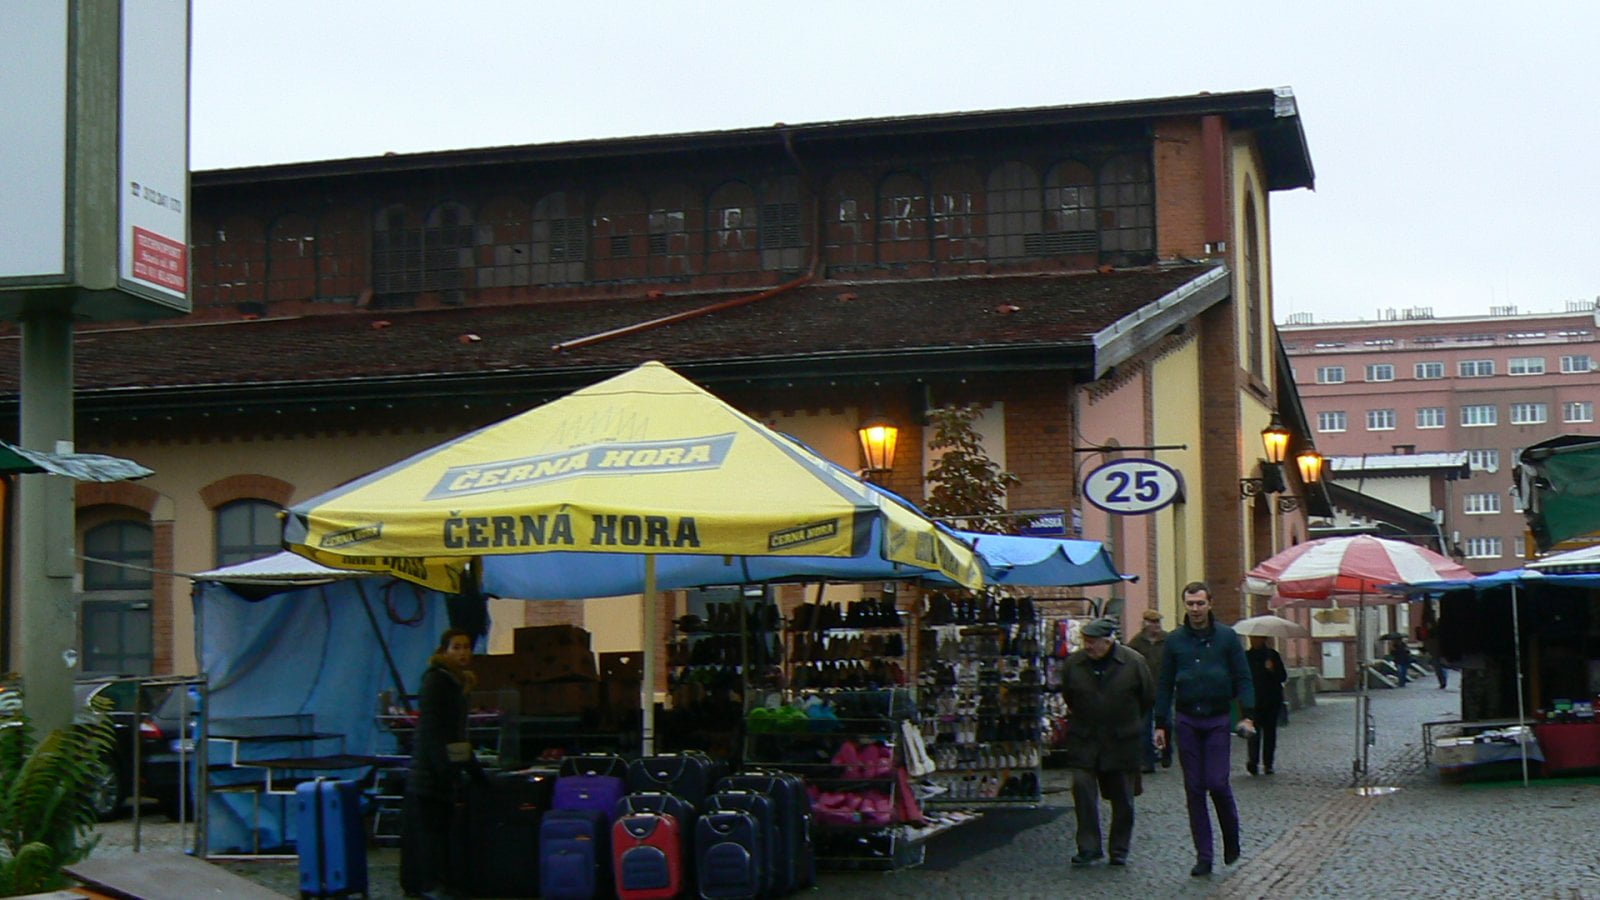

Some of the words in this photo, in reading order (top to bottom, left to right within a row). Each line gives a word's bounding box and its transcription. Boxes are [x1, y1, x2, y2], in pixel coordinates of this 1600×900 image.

[597, 444, 711, 468] HORA
[1105, 470, 1161, 503] 25
[443, 503, 575, 548] ČERNÁ
[591, 513, 700, 548] HORA
